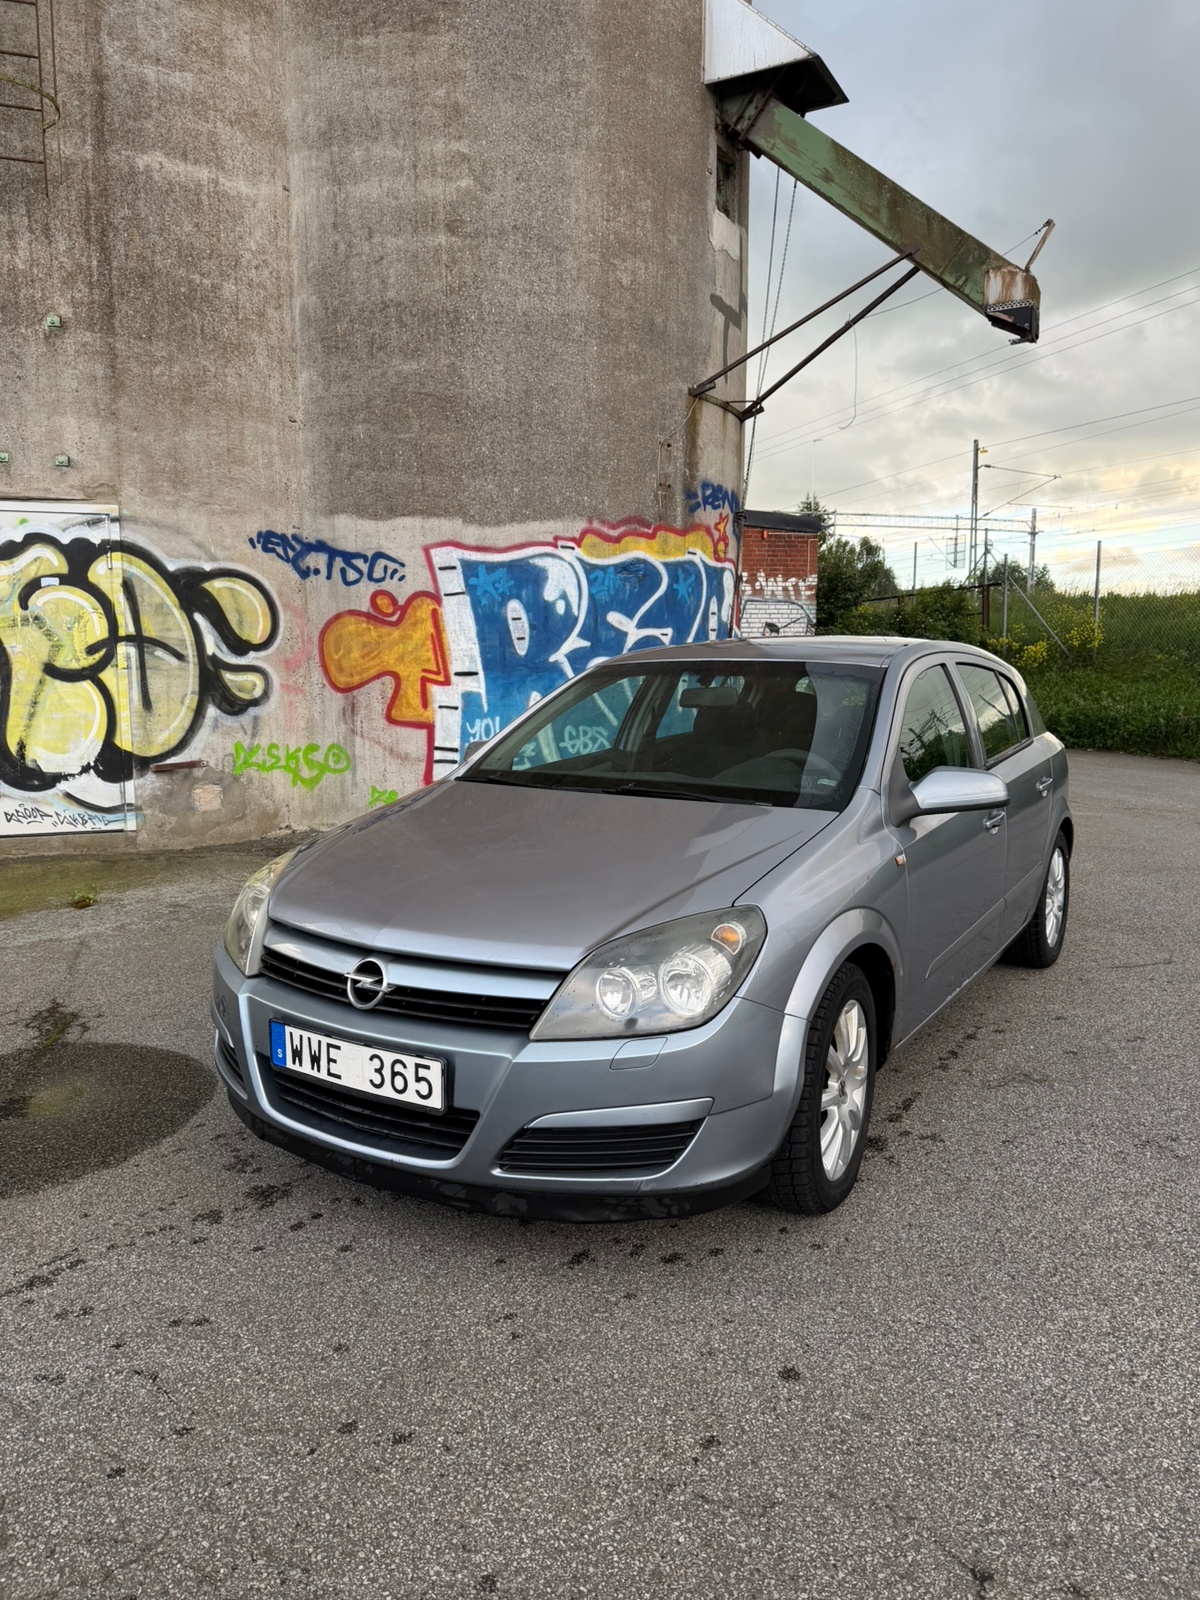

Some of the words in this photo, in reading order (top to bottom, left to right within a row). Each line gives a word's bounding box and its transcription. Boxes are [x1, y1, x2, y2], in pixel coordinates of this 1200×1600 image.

[277, 1049, 283, 1058] S
[289, 1031, 342, 1080] WWE
[368, 1053, 433, 1100] 365
